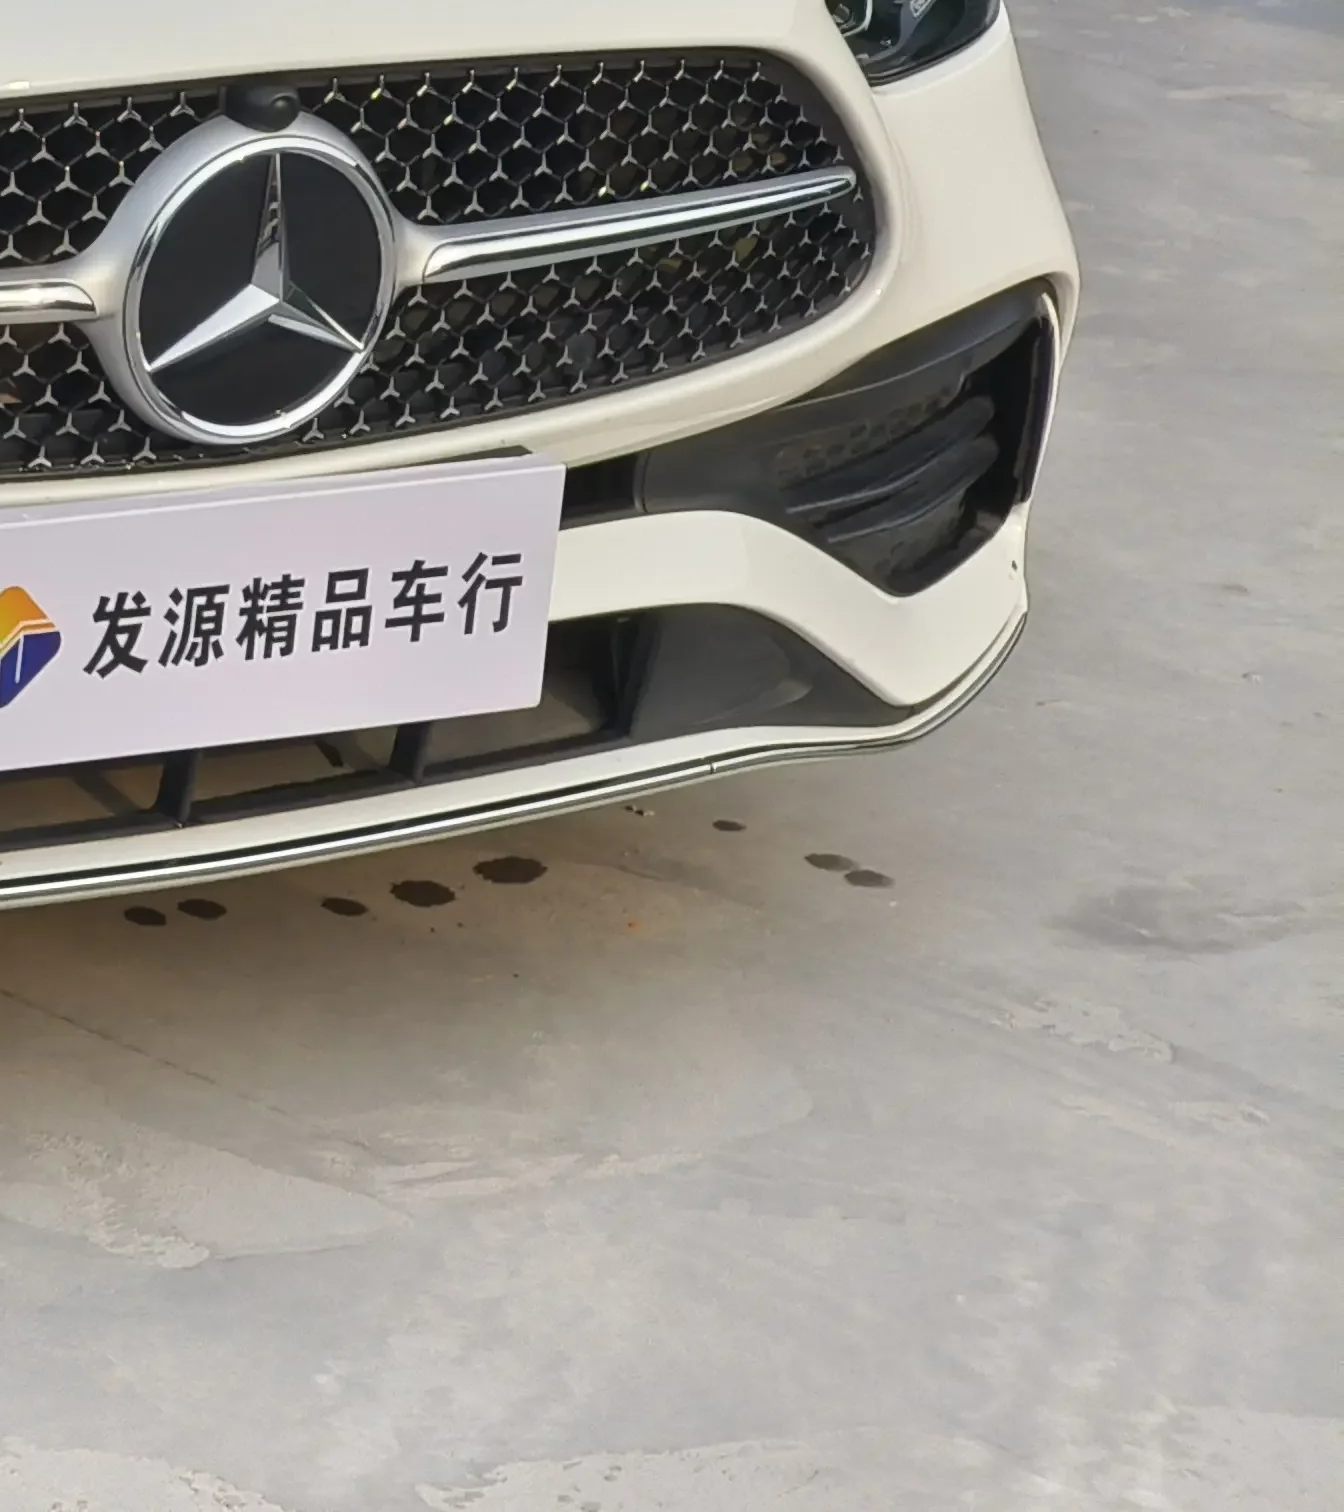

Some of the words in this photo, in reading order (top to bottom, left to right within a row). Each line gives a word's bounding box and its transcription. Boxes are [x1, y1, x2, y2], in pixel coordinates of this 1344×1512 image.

[83, 552, 524, 679] 发源精品车行
